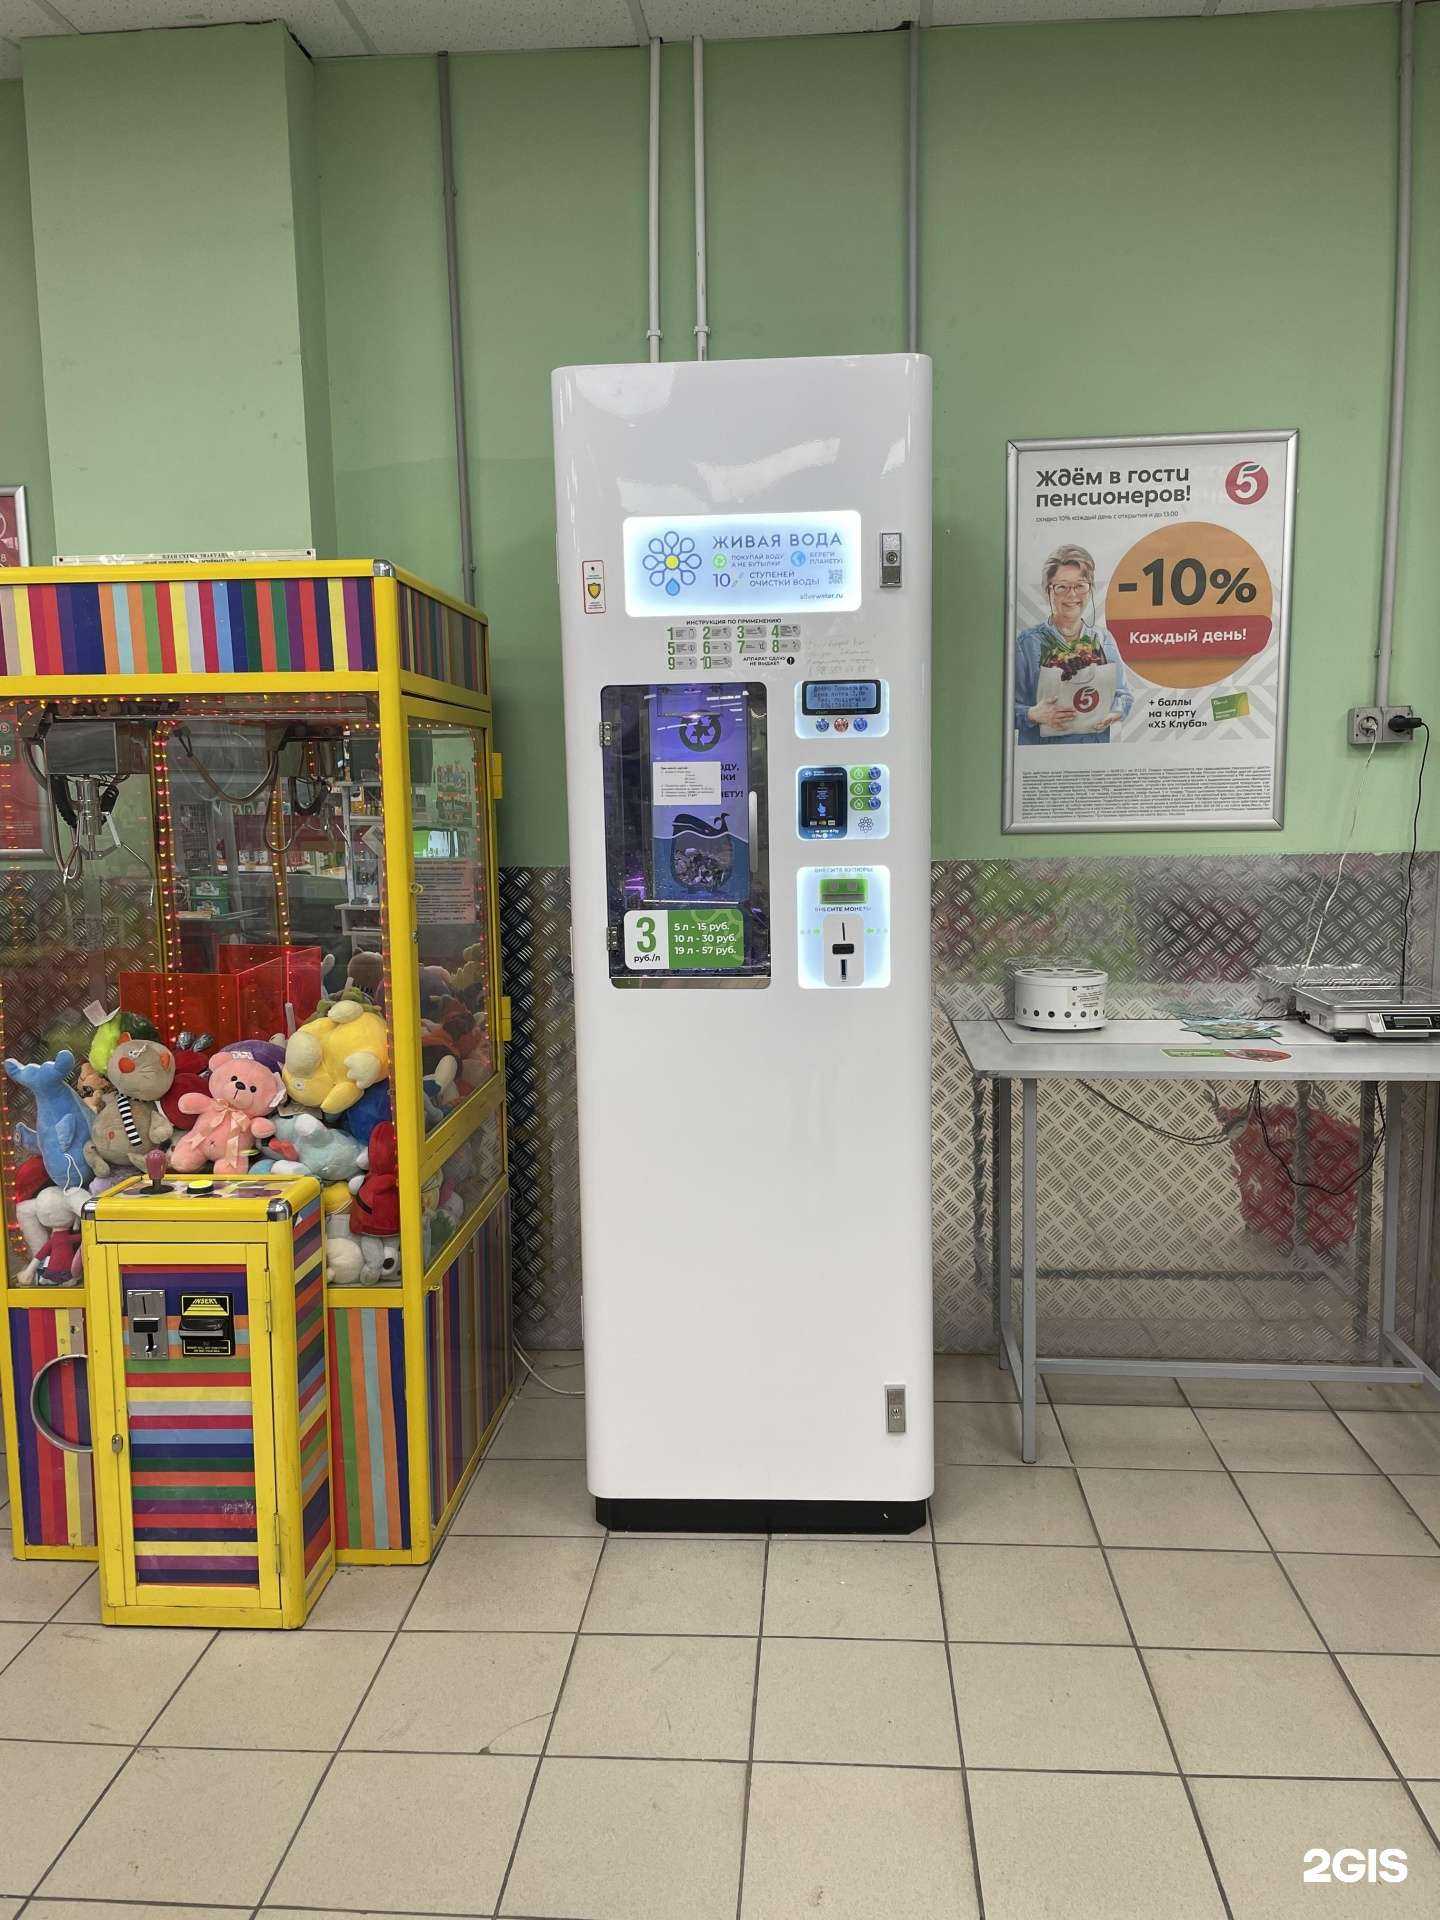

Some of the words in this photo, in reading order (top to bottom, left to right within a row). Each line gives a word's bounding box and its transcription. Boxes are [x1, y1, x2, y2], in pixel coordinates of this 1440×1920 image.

[1035, 467, 1102, 488] Ждём
[1109, 471, 1121, 484] в
[1127, 467, 1189, 484] гости
[1035, 485, 1191, 508] пенсионеров!
[712, 534, 780, 549] ЖИВАЯ
[790, 532, 842, 547] ВОДА
[712, 572, 730, 588] 10
[750, 571, 795, 579] СТУПЕНЕЙ
[750, 579, 790, 587] ОЧИСТКИ
[1118, 558, 1256, 606] -10%
[667, 627, 674, 640] 1
[703, 626, 711, 640] 2
[737, 626, 745, 639] 3
[772, 625, 779, 638] 4
[1129, 628, 1198, 644] Каждый
[1202, 628, 1247, 643] день!
[667, 642, 675, 655] 5
[703, 641, 711, 655] 6
[737, 640, 745, 653] 7
[772, 640, 779, 653] 8
[668, 656, 675, 670] 9
[1158, 697, 1192, 707] баллы
[1165, 708, 1196, 719] карту
[1169, 720, 1207, 729] Клуба»
[709, 922, 729, 932] руб.
[636, 917, 657, 953] 3
[717, 934, 737, 944] руб.
[716, 946, 737, 956] руб.
[634, 954, 661, 962] руб./л
